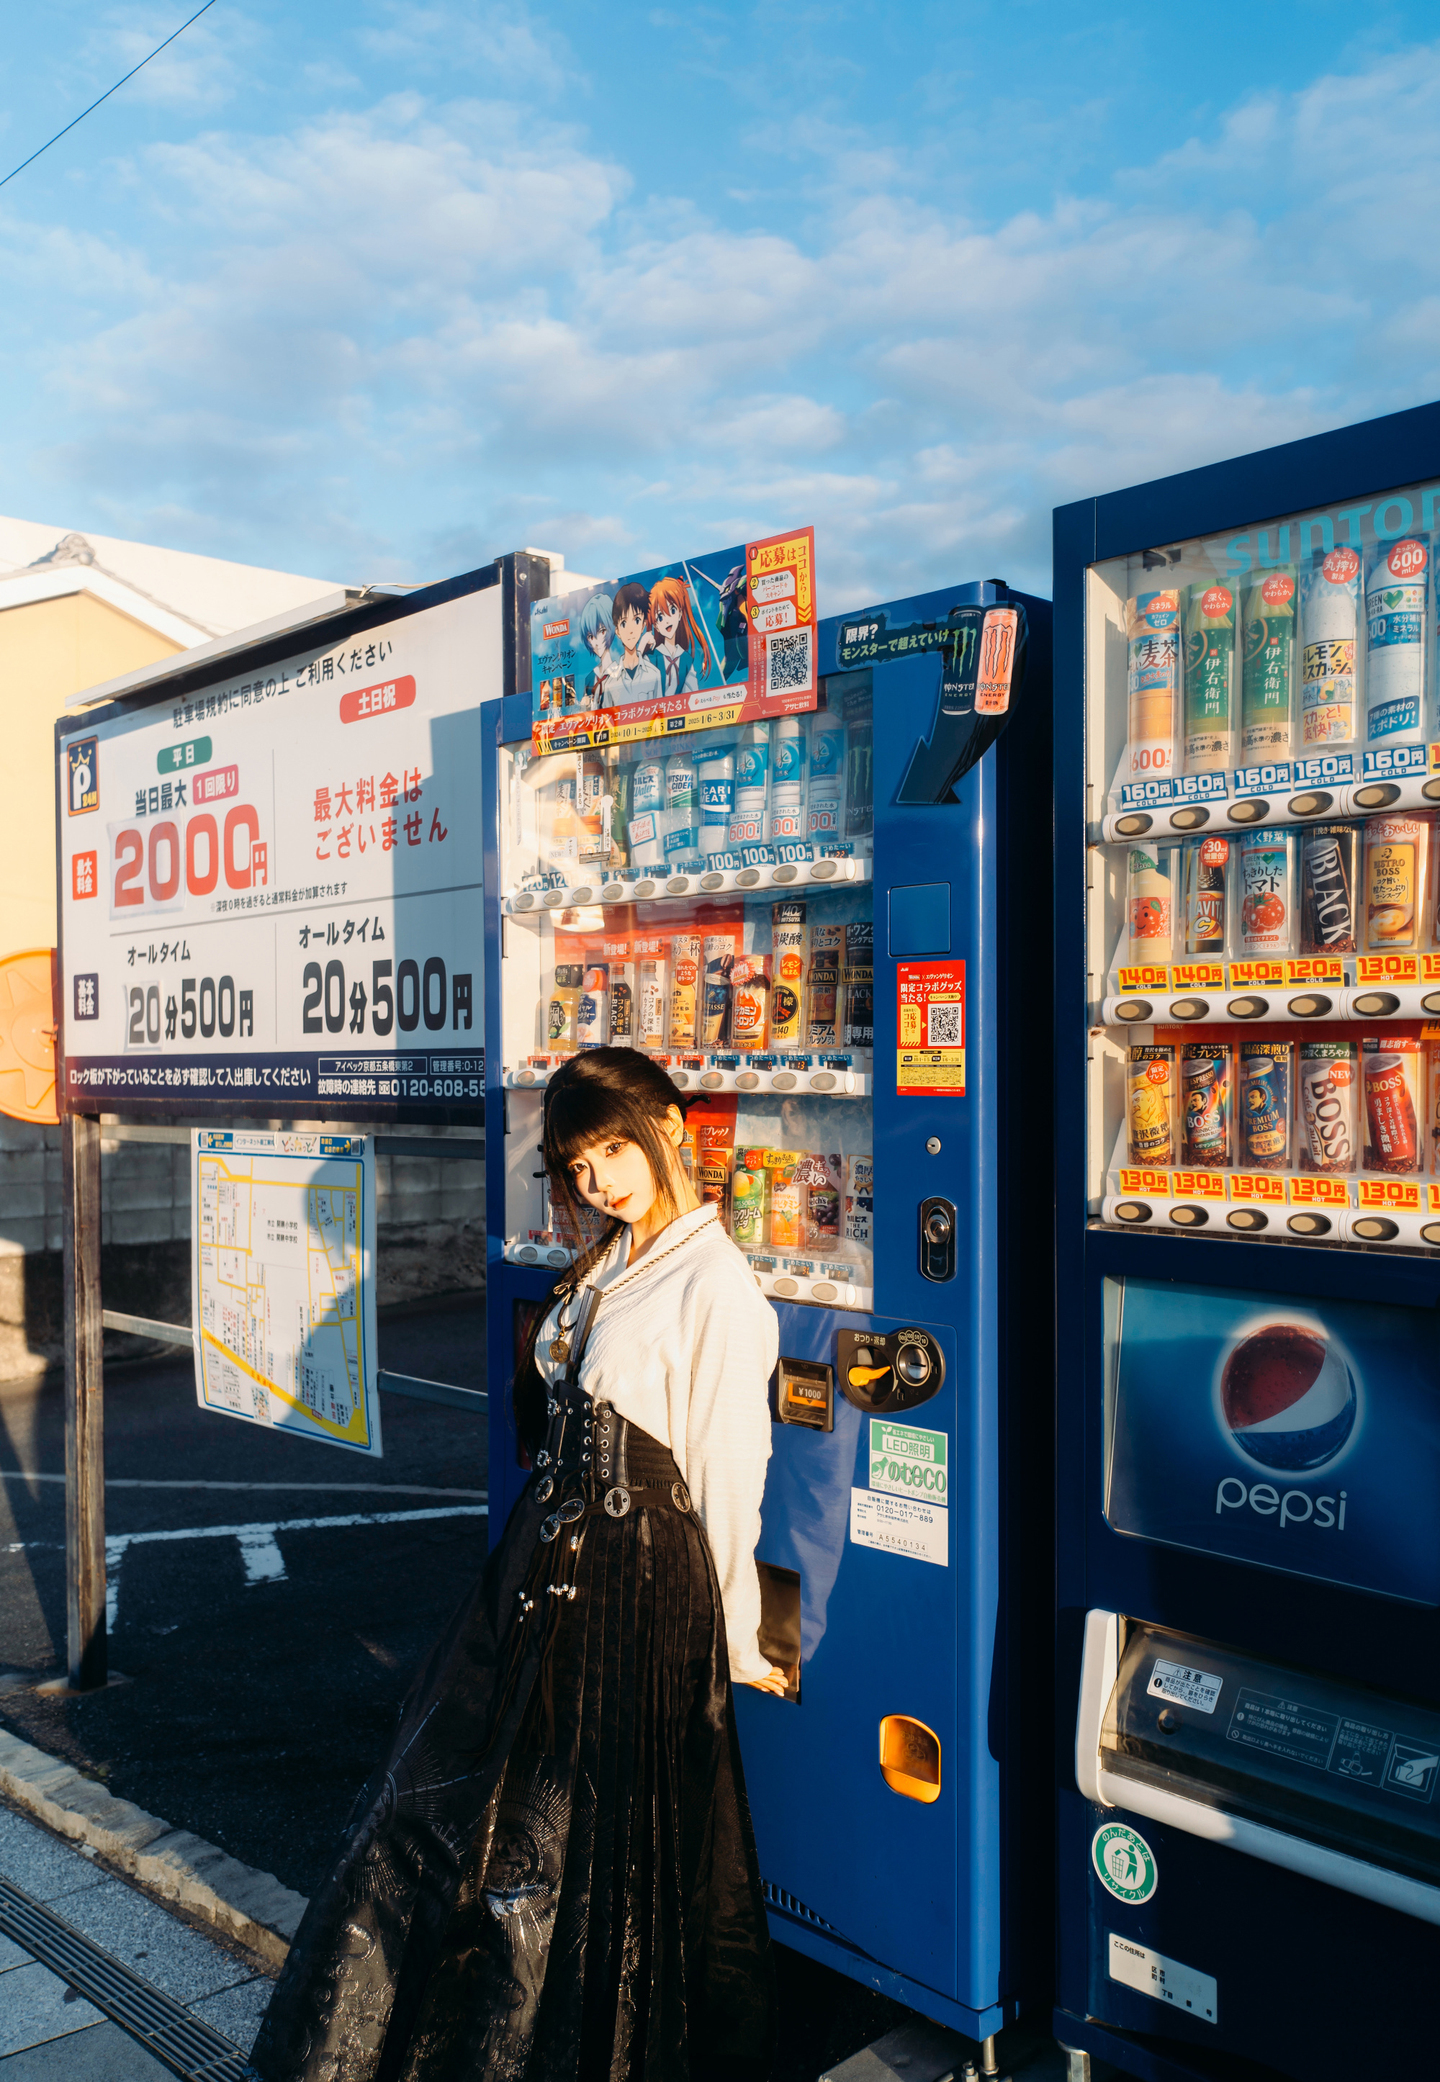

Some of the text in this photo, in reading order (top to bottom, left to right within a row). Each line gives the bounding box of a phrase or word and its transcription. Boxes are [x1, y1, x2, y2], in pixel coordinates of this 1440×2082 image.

[1395, 543, 1416, 554] たっぷり
[760, 546, 796, 569] 応募は
[1391, 549, 1423, 571] 600
[1325, 561, 1359, 572] 丸搾り
[1401, 565, 1415, 575] ml!
[752, 579, 756, 587] 2
[1269, 579, 1288, 590] 深く、
[1331, 572, 1345, 581] 製法
[1203, 602, 1230, 610] やわらか。
[1208, 593, 1226, 602] 深く、
[753, 608, 757, 616] 3
[765, 612, 787, 628] 応募!
[545, 624, 567, 636] WONDA
[846, 624, 878, 644] 限界?
[1393, 625, 1419, 633] ミネラル
[842, 630, 949, 660] モンスターで超えていけ
[1307, 644, 1342, 659] レモン
[1142, 639, 1178, 670] 麦茶
[542, 661, 572, 674] キャンペーン
[1264, 647, 1282, 705] 伊右衛門
[1307, 660, 1352, 679] スカッシュ
[173, 640, 393, 728] 駐車場規約に同意の上 ご利用ください
[1205, 658, 1221, 714] 伊右衛門
[358, 684, 396, 716] 土日祝
[785, 701, 809, 711] アサヒ飲料
[560, 699, 687, 730] エヴァンゲリオン コラボグッズ当たる!
[1304, 705, 1341, 725] スカッと!
[1369, 701, 1415, 719] 7種の素材の
[670, 720, 683, 728] 第2弾
[1369, 710, 1416, 737] スポドリ!
[554, 736, 586, 748] キャンペーン期間
[172, 744, 194, 768] 平日
[1364, 746, 1425, 772] 160円
[1236, 764, 1288, 787] 160円
[1295, 756, 1352, 780] 160円
[1381, 767, 1407, 776] COLD
[196, 770, 236, 800] 1回限り
[672, 782, 693, 790] CIDER
[1174, 774, 1225, 794] 160円
[1250, 784, 1274, 792] COLD
[1310, 776, 1335, 785] COLD
[82, 791, 97, 808] 24H
[136, 780, 187, 818] 当日最大
[313, 766, 422, 822] 最大料金は
[1124, 780, 1171, 802] 160円
[1188, 792, 1210, 800] COLD
[1136, 799, 1158, 807] COLD
[316, 807, 448, 860] ございません
[729, 822, 756, 843] 600
[744, 847, 774, 864] 100円
[779, 844, 812, 862] 100円
[76, 859, 92, 876] 最大
[710, 854, 740, 871] 100円
[1373, 859, 1405, 868] BISTRO
[1376, 867, 1400, 877] BOSS
[76, 875, 92, 894] 料金
[1245, 876, 1280, 894] トマト
[1377, 877, 1400, 885] コク旨い
[1310, 849, 1351, 944] BLACK
[299, 916, 385, 949] オールタイム
[773, 932, 802, 948] 強炭酸
[127, 940, 191, 966] オールタイム
[604, 943, 627, 956] 新登場!
[634, 941, 659, 953] 新登場!
[781, 960, 801, 968] レモン
[1231, 963, 1282, 980] 140円
[1287, 960, 1342, 977] 120円
[1359, 956, 1416, 974] 130円
[845, 968, 873, 980] WONDA
[1120, 968, 1167, 984] 140円
[1173, 966, 1222, 982] 140円
[901, 981, 962, 993] 限定コラボグッズ
[303, 957, 473, 1036] 20分500円
[901, 994, 926, 1003] 当たる!
[78, 997, 94, 1016] 料金
[129, 975, 253, 1044] 20分500円
[1244, 1044, 1290, 1055] 最高深煎り
[1380, 1040, 1423, 1048] 闘志宿す一杯
[1197, 1050, 1229, 1058] ブレンド
[335, 1061, 413, 1072] アイペック京都五条橋東第2
[1151, 1066, 1164, 1074] 限定
[1330, 1071, 1354, 1079] NEW
[70, 1067, 311, 1087] ロック板が下がっていることを必ず確認して入出庫してください
[1149, 1071, 1169, 1080] ブレンド
[1373, 1075, 1401, 1092] BOSS
[318, 1079, 376, 1095] 故障時の連絡先
[1187, 1110, 1221, 1128] BOSS
[1245, 1109, 1280, 1125] PREMIUM
[1311, 1079, 1350, 1160] BOSS
[1374, 1098, 1392, 1153] 男ましき微糖
[1253, 1122, 1273, 1132] BOSS
[698, 1167, 723, 1178] WONDA
[1121, 1170, 1168, 1187] 130円
[1174, 1172, 1221, 1190] 130円
[1232, 1174, 1283, 1193] 130円
[1291, 1179, 1346, 1198] 130円
[1360, 1181, 1418, 1201] 130円
[735, 1220, 749, 1228] ソーダ
[846, 1229, 868, 1238] RICH
[798, 1387, 822, 1400] ¥1000
[887, 1438, 930, 1458] LED照明
[888, 1461, 946, 1493] のむeco
[1215, 1477, 1348, 1532] pepsi
[876, 1505, 933, 1523] 0120-017-889
[857, 1529, 873, 1537] 管理番号
[1182, 1670, 1202, 1683] 注意
[1165, 1677, 1216, 1696] 商品が出たことを確認
[1162, 1688, 1204, 1706] 取り出してください。
[1344, 1722, 1389, 1739] 商品の取り出し方
[1102, 1828, 1151, 1862] のんだあとは
[1103, 1873, 1145, 1900] リサイクル
[1114, 1941, 1145, 1959] ここの住所は
[1162, 1989, 1173, 1999] 丁目
